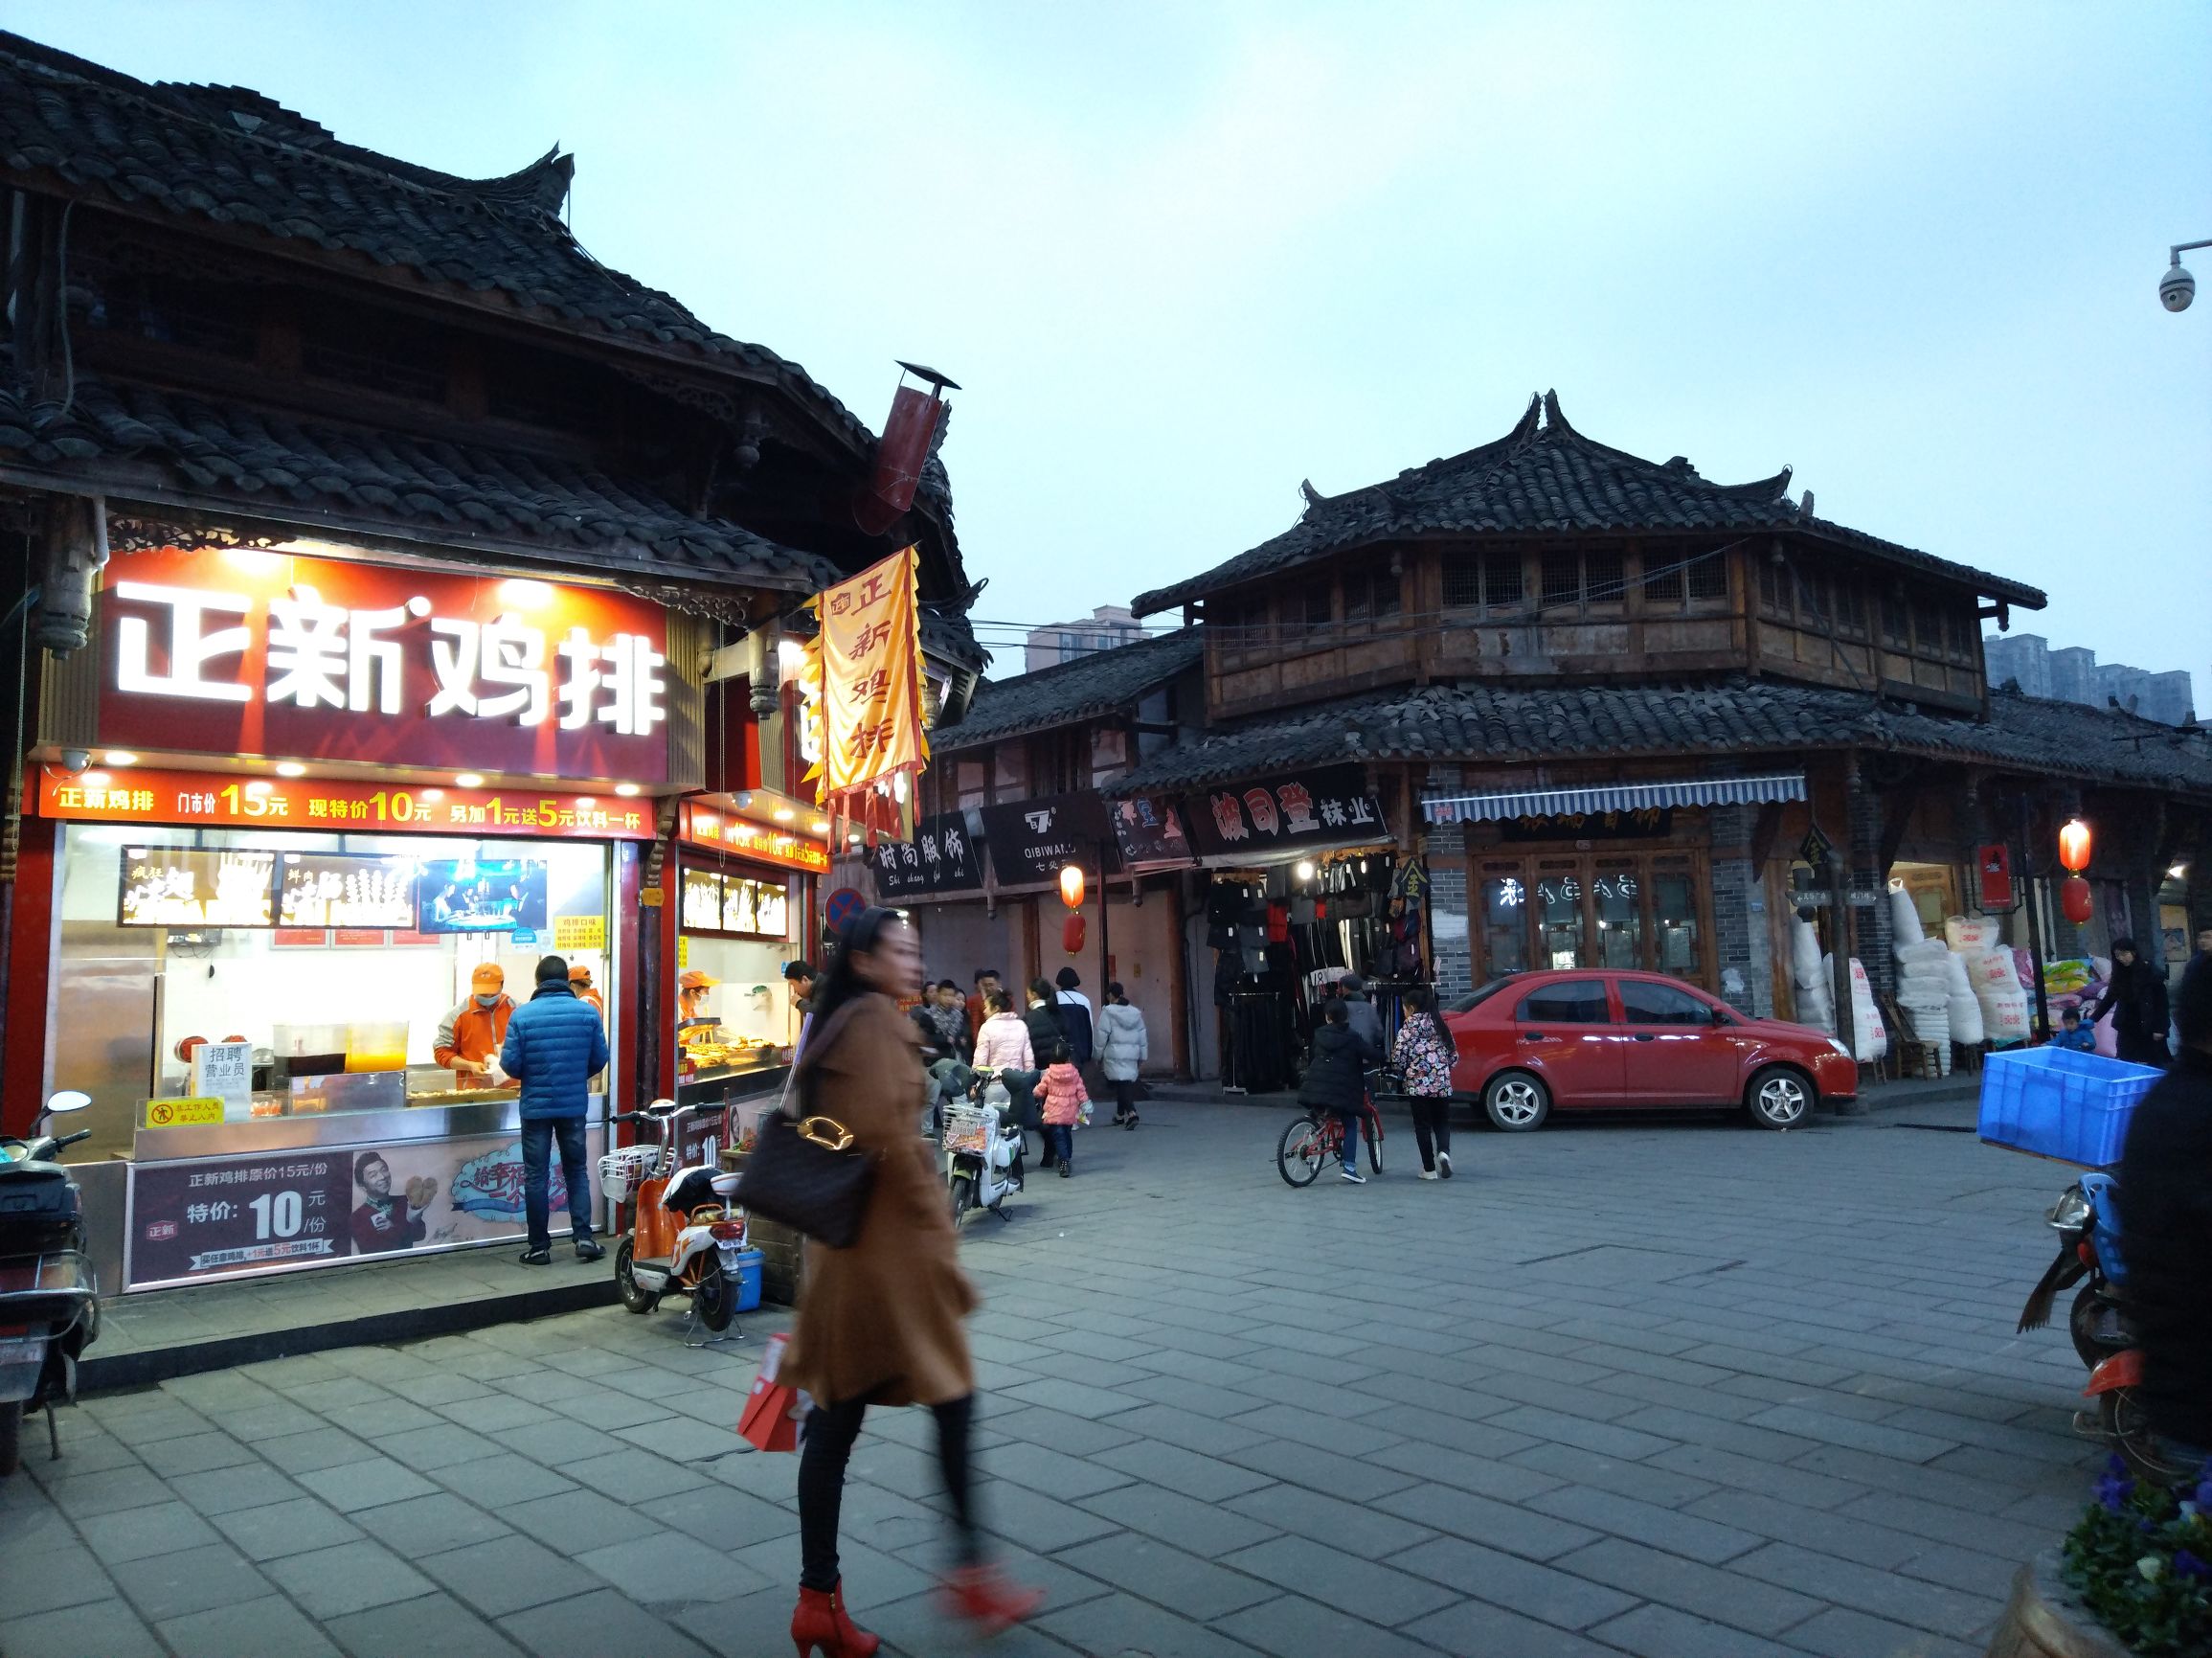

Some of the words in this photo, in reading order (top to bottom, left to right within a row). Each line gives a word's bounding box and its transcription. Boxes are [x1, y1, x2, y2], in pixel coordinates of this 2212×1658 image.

[116, 579, 666, 737] 正新鸡排
[848, 574, 894, 760] 正新鸡排
[59, 785, 154, 812] 正新鸡排
[177, 782, 288, 817] 门市价15元
[308, 791, 432, 822] 现特价10元
[450, 796, 641, 830] 另加1元送5元饮料一杯
[1210, 782, 1374, 841] 波司登袜业
[879, 828, 963, 870] 时尚服饰
[205, 1062, 245, 1079] 营业员
[210, 1046, 243, 1062] 招聘
[189, 1163, 327, 1188] 正新鸡排原价15元/份
[149, 1224, 174, 1238] 正新
[249, 1190, 303, 1240] 10
[308, 1190, 326, 1207] 元
